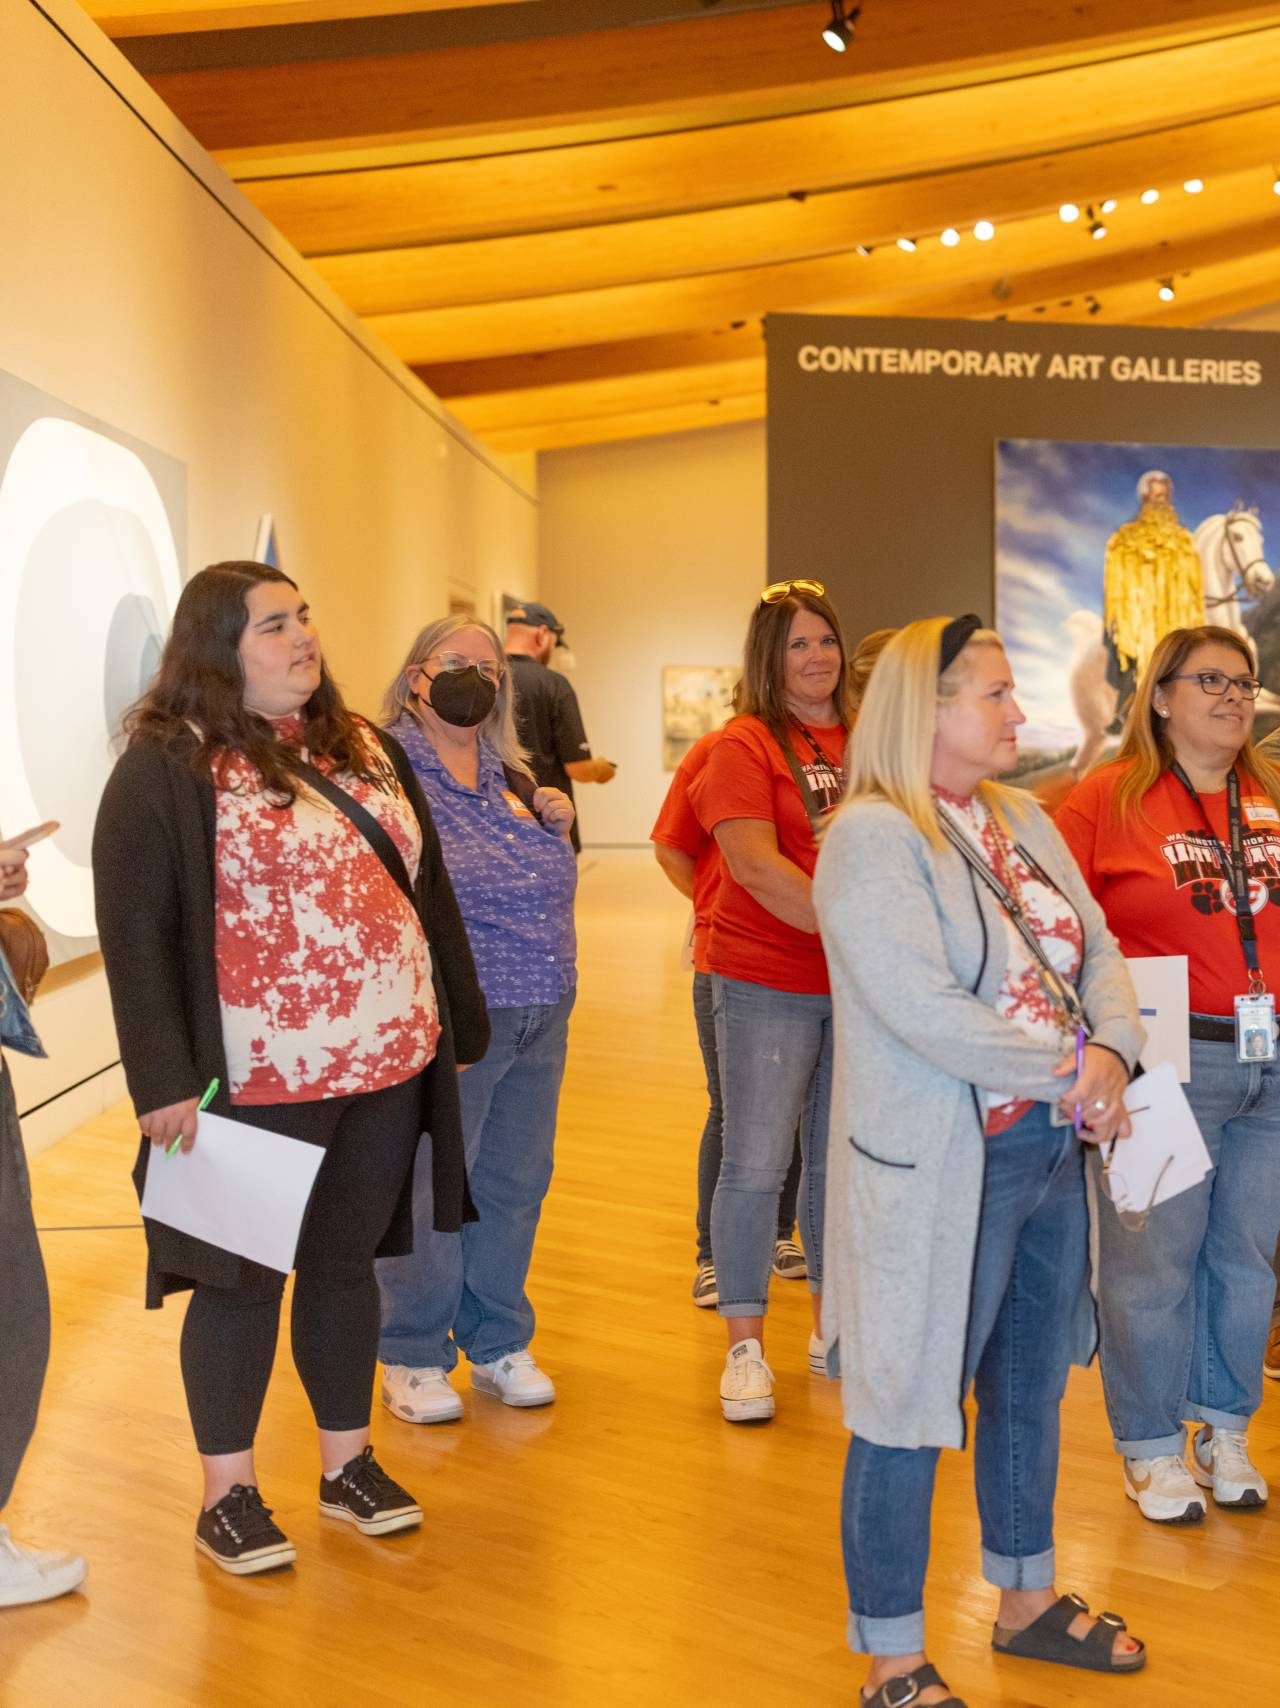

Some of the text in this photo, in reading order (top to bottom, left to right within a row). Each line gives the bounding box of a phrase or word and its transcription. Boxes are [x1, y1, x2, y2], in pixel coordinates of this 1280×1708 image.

[798, 345, 1262, 386] CONTEMPORARY ART GALLERIES
